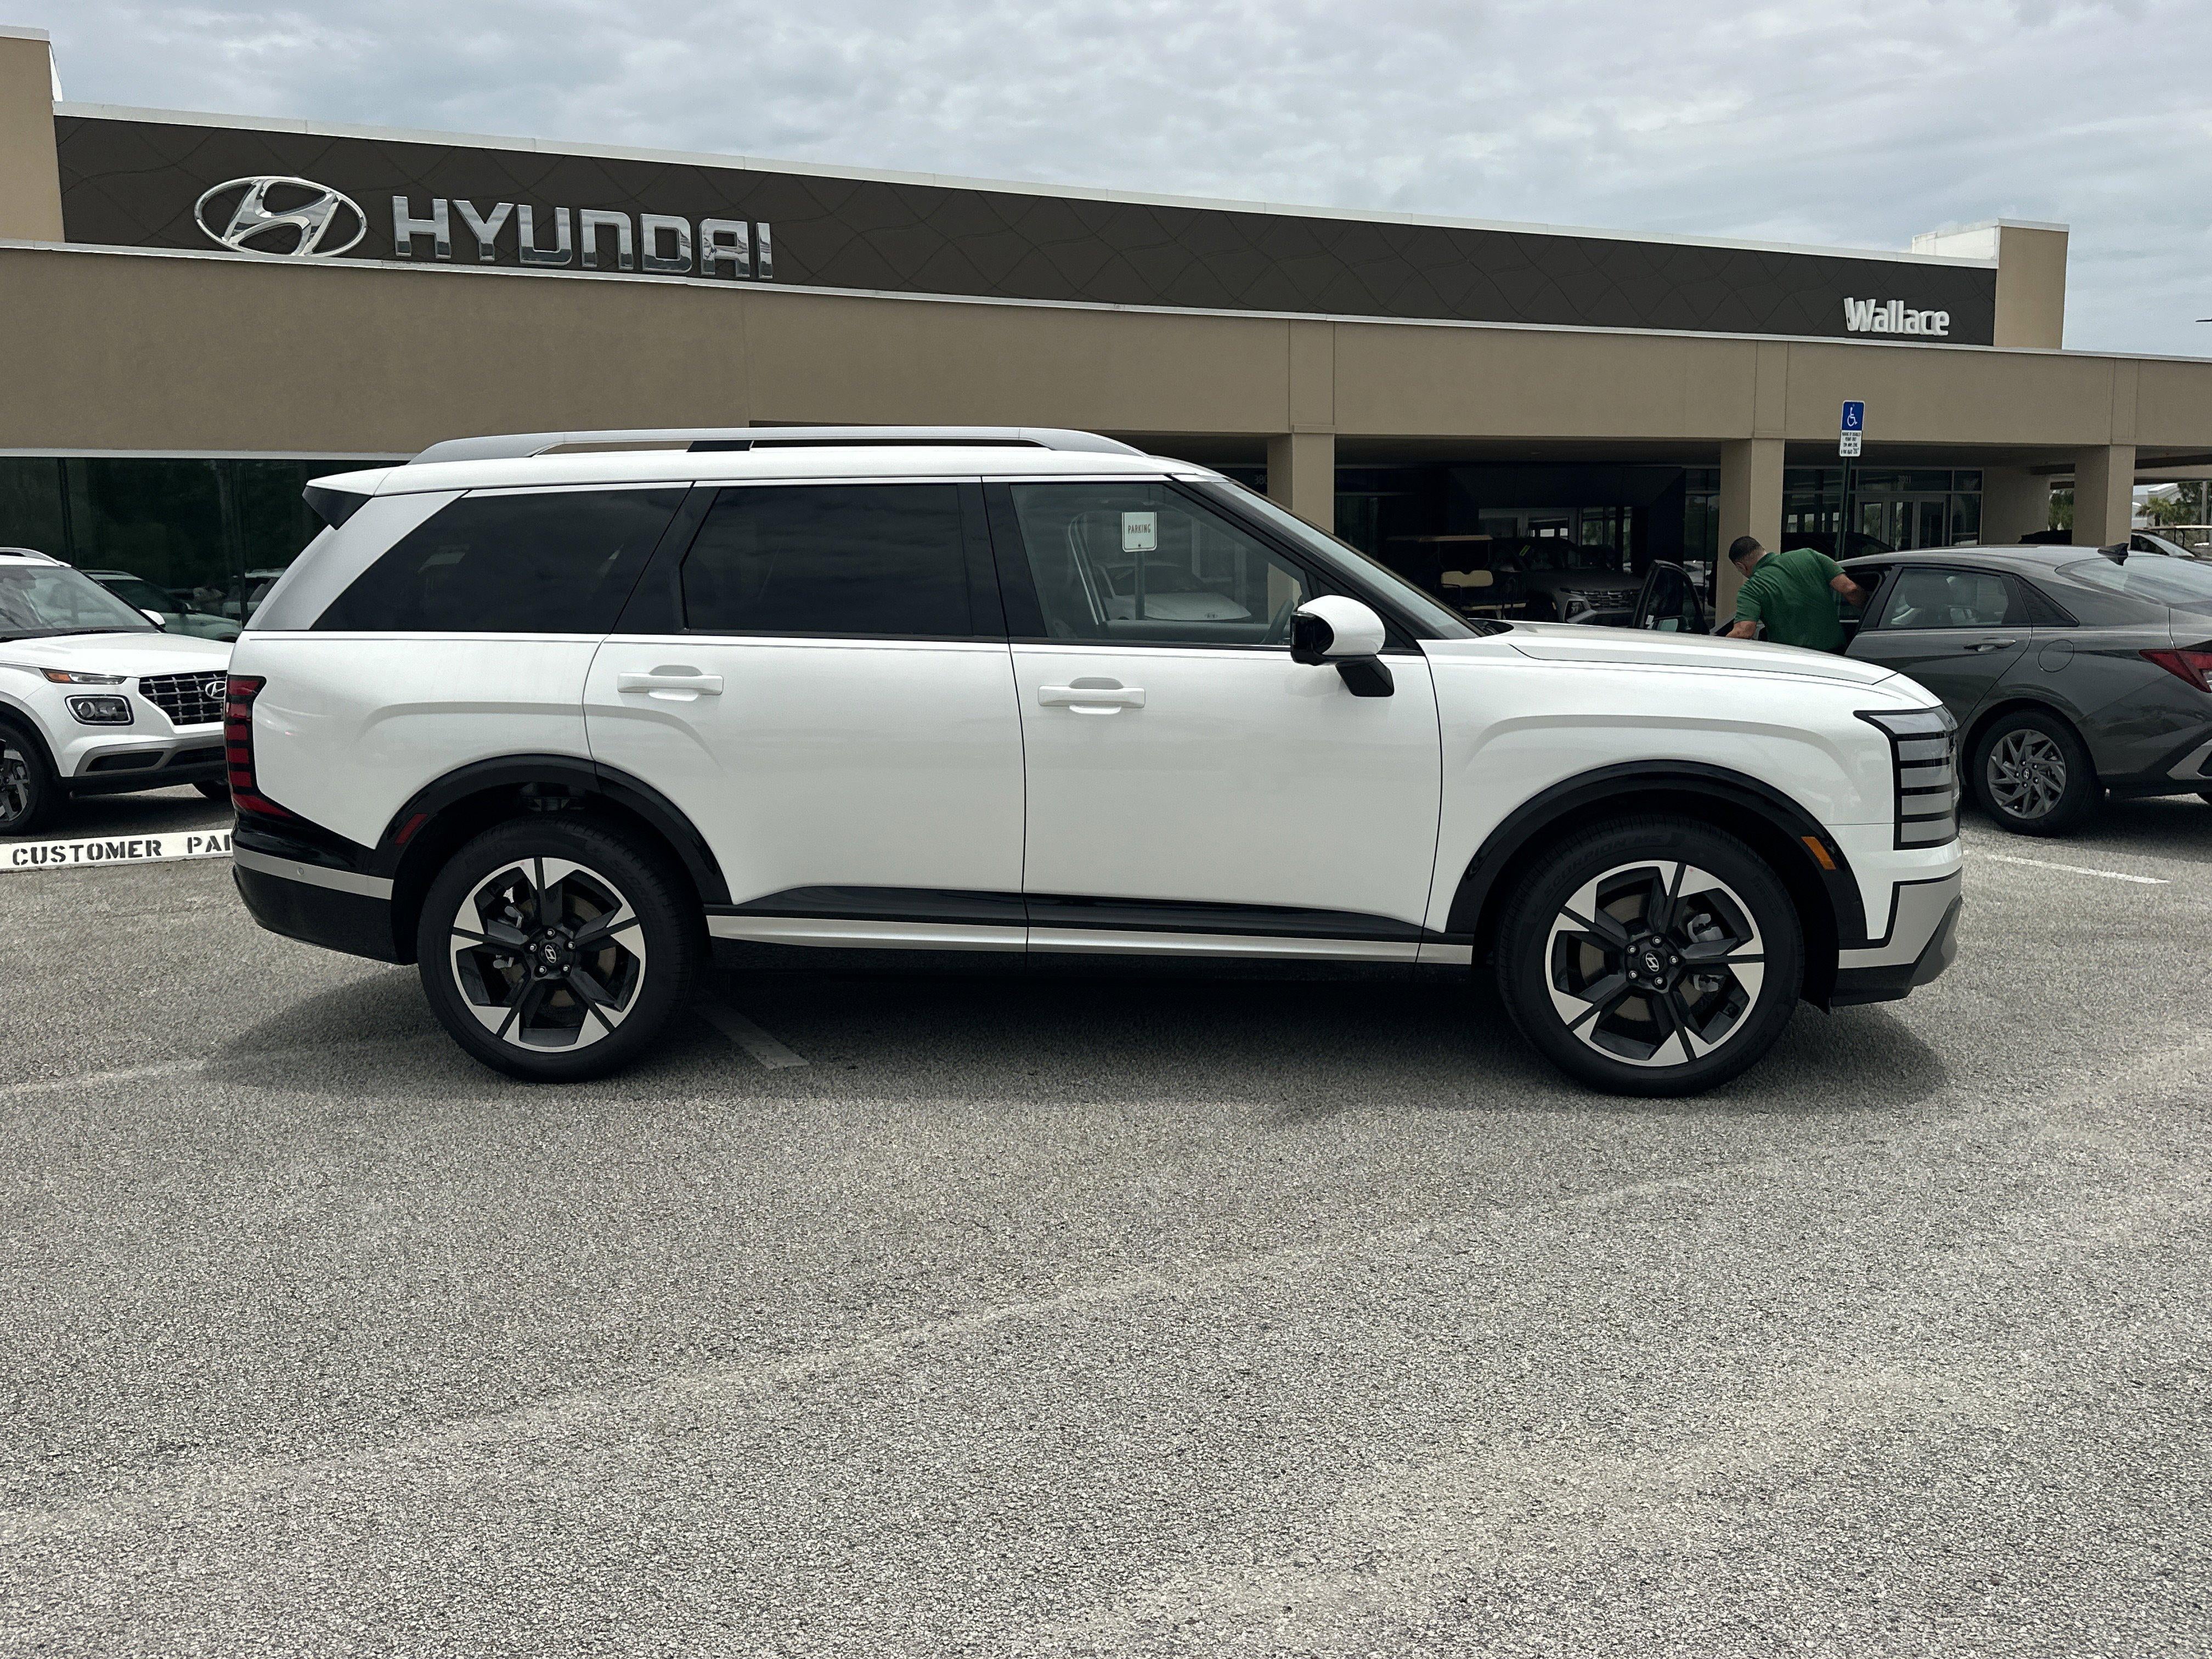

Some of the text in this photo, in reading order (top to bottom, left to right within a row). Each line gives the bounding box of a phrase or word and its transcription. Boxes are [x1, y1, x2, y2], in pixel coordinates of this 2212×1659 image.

[392, 195, 774, 279] HYUNDAI
[1844, 297, 1950, 336] Wallace
[1128, 524, 1151, 534] PARKING
[12, 839, 162, 866] CUSTOMER
